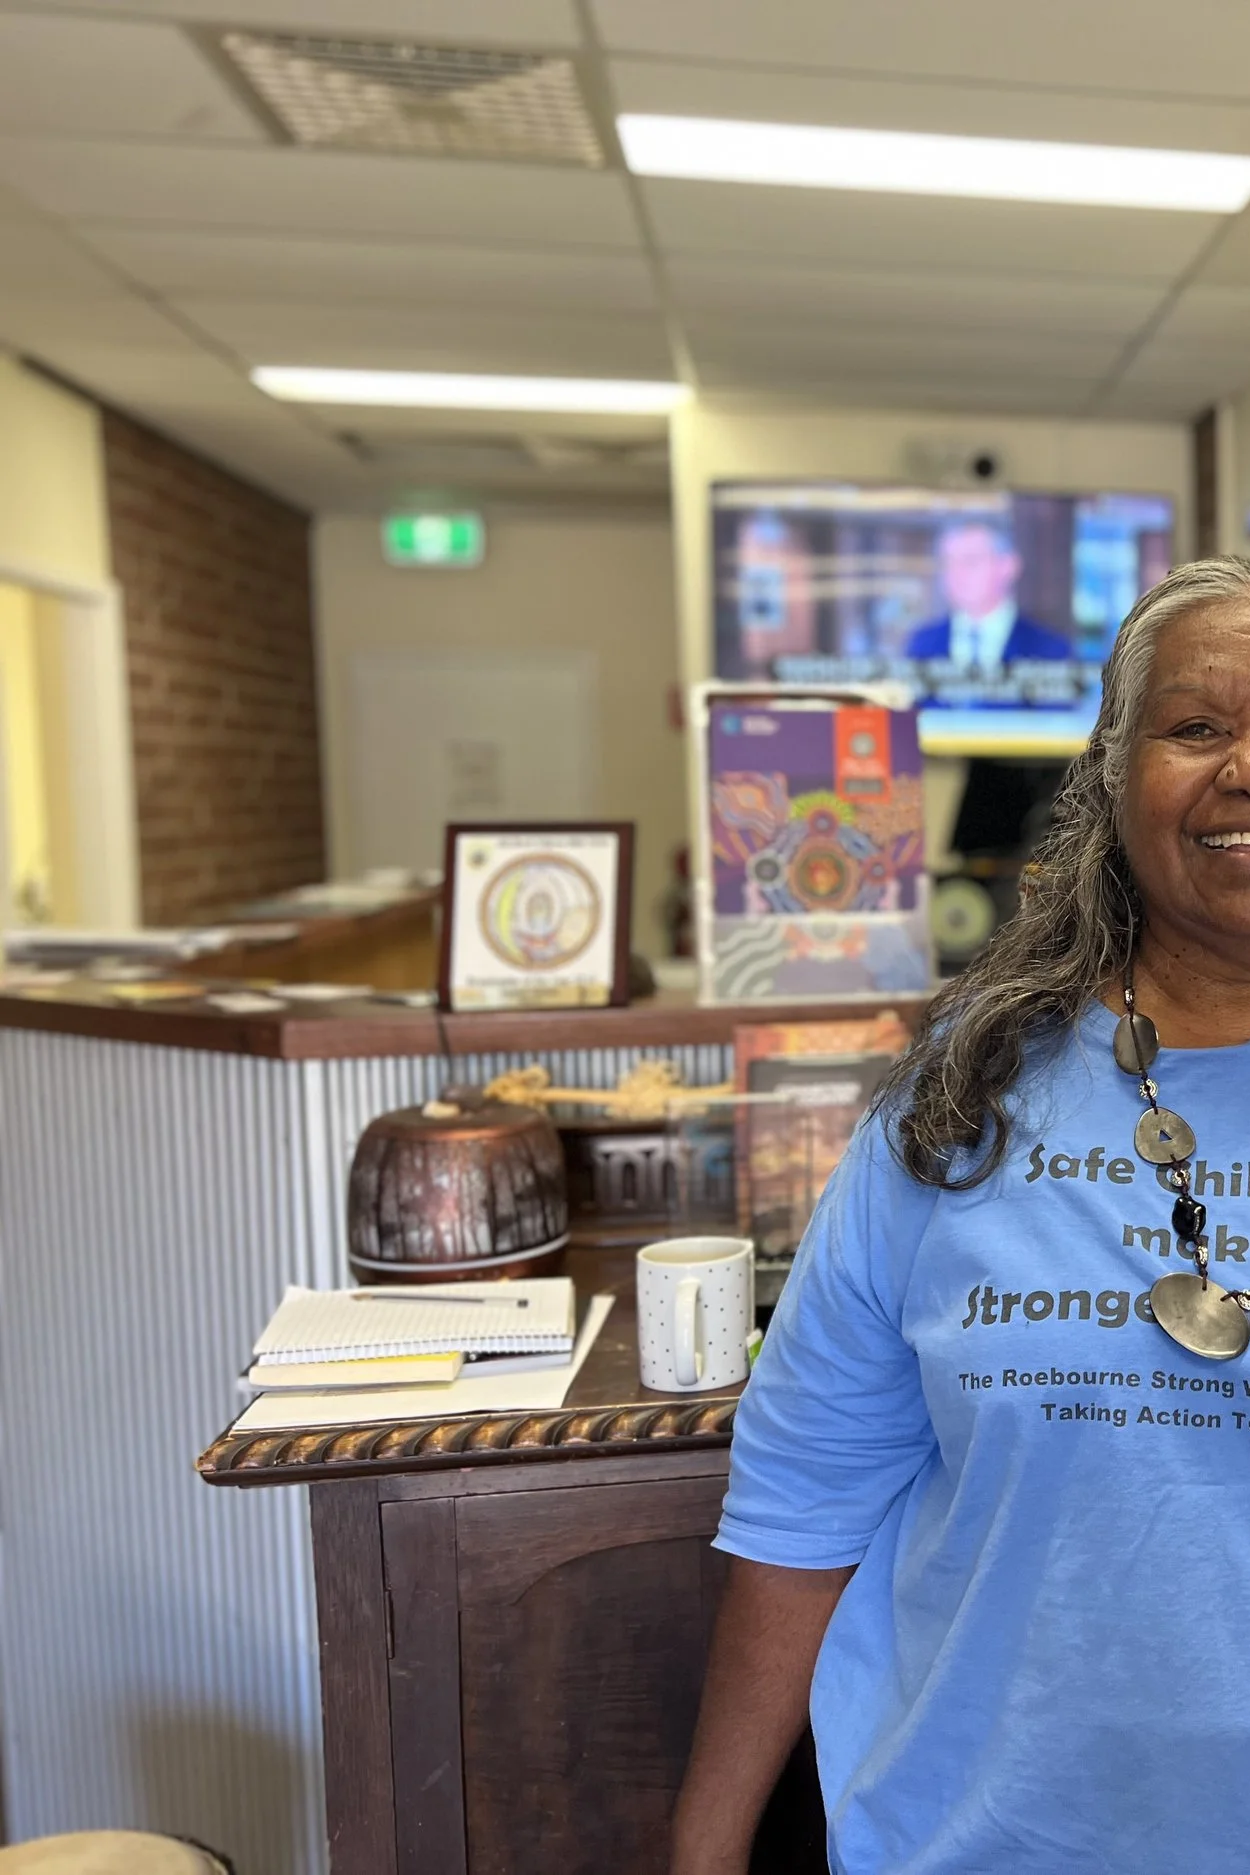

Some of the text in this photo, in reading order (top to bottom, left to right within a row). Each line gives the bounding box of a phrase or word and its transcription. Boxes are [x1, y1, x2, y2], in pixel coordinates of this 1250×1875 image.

[1025, 1142, 1136, 1184] Safe
[959, 1372, 993, 1391] The
[1001, 1367, 1141, 1389] Roebourne
[1150, 1369, 1236, 1400] Strong
[1040, 1402, 1128, 1429] Taking
[1136, 1405, 1222, 1430] Action
